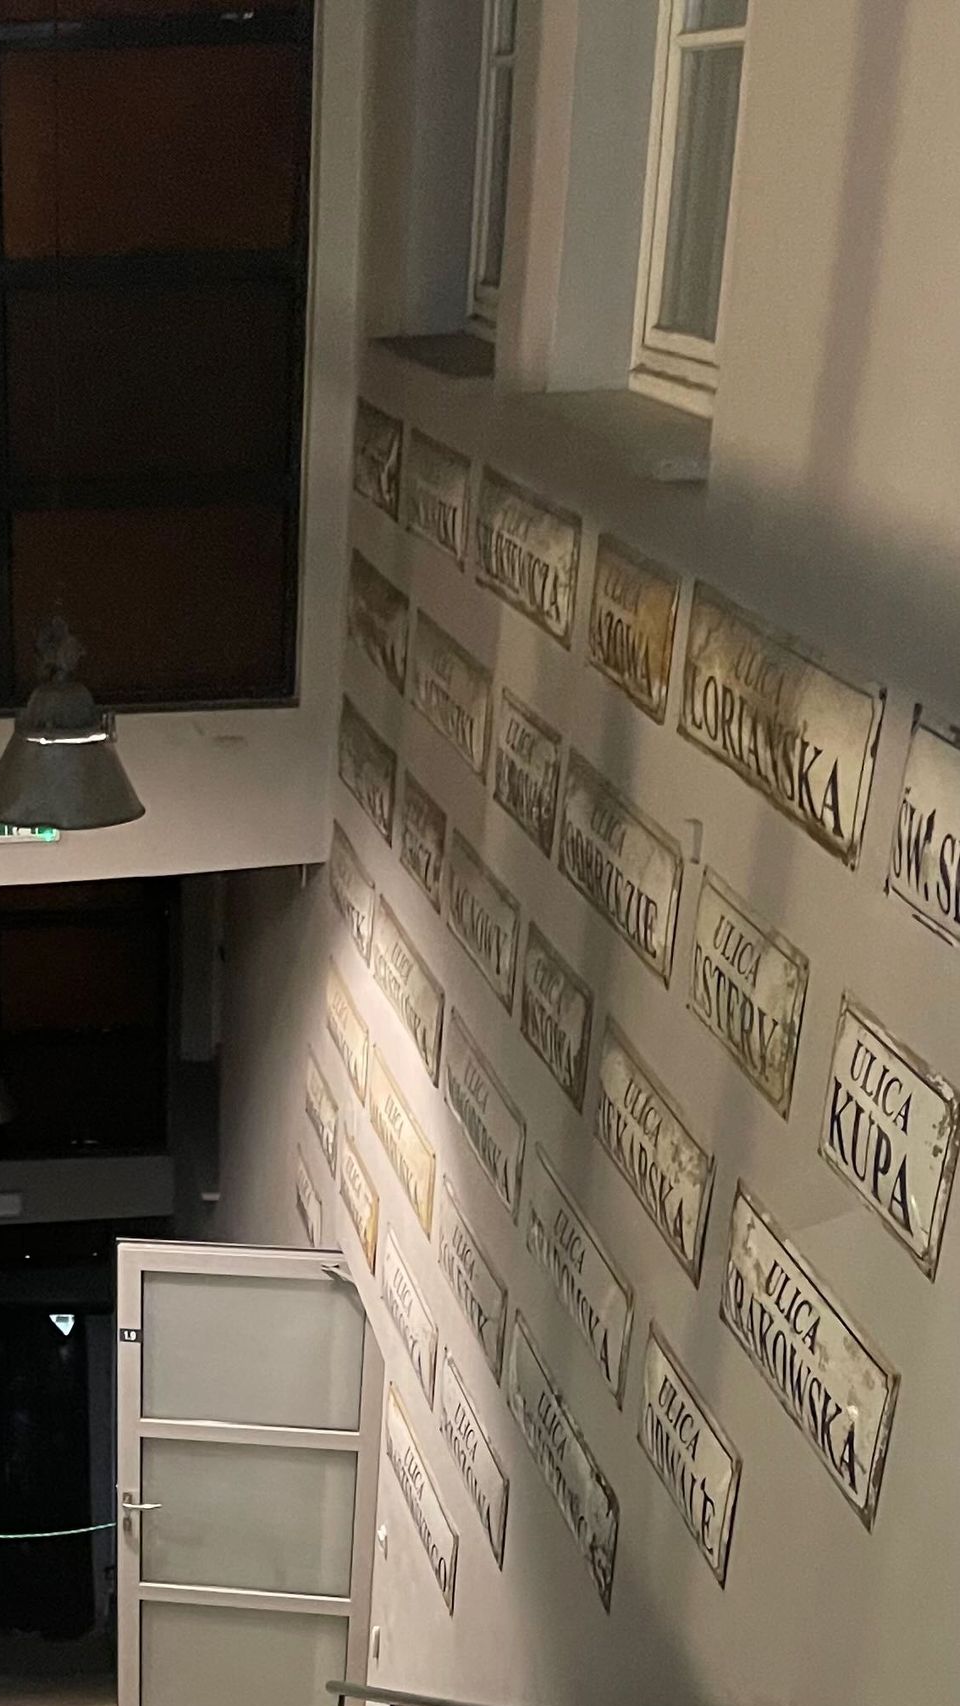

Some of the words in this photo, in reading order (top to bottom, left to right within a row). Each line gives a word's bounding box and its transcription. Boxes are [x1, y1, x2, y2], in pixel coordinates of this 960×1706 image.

[713, 913, 763, 990] ULICA
[624, 1077, 663, 1149] ULICA
[850, 1039, 913, 1137] ULICA
[827, 1075, 914, 1237] KUPA
[765, 1259, 821, 1356] ULICA
[658, 1374, 701, 1462] ULICA
[724, 1258, 858, 1495] KRAKOWSKA
